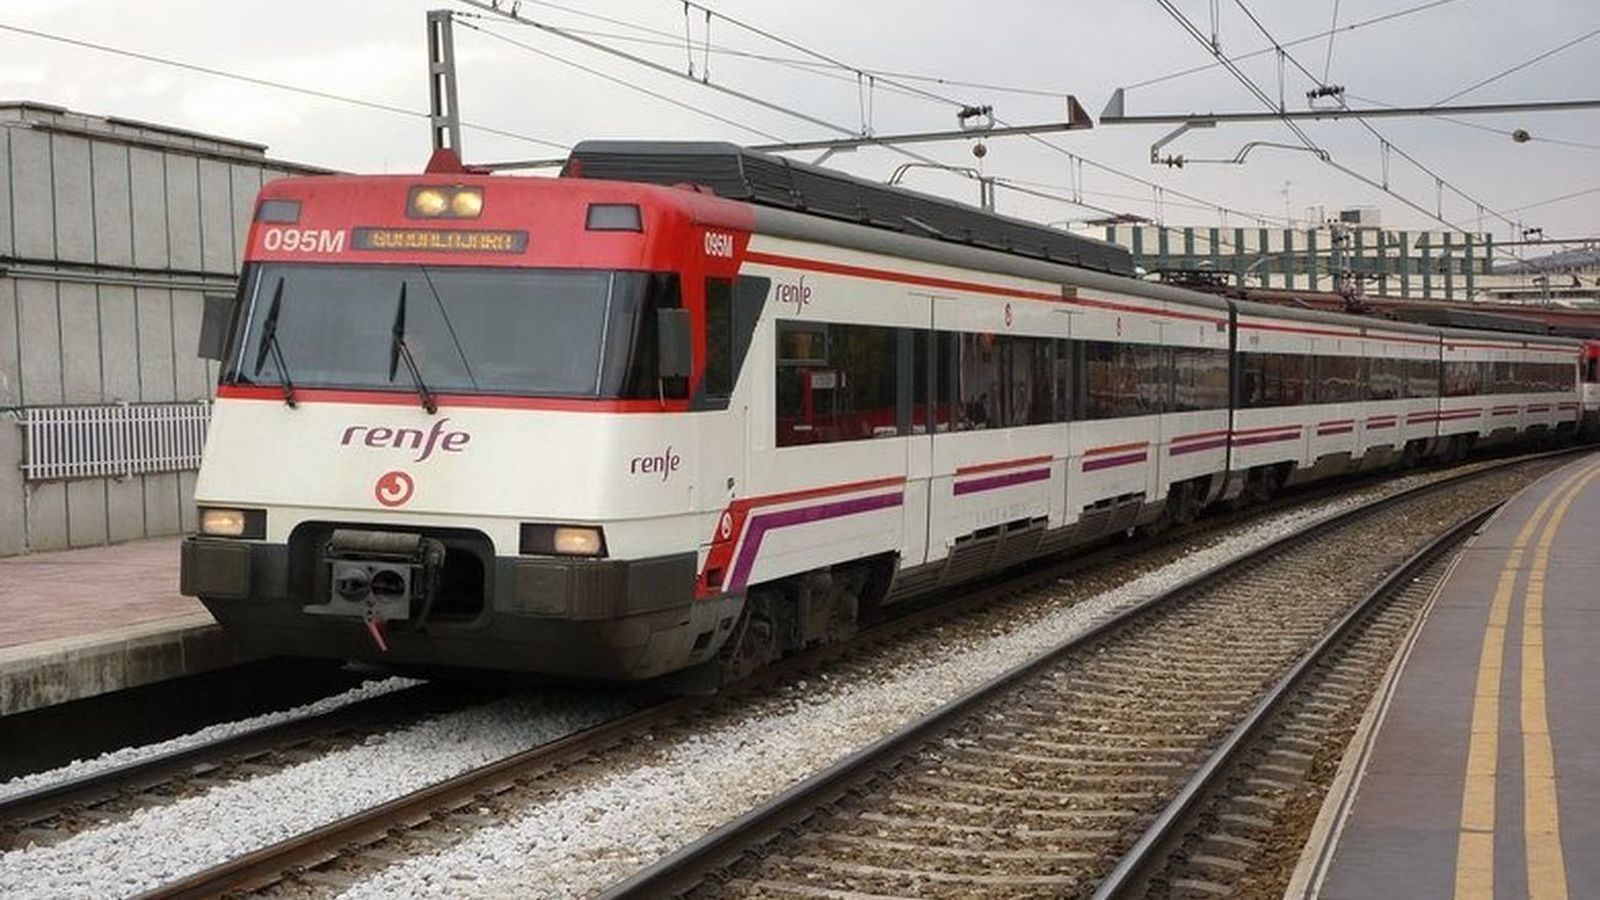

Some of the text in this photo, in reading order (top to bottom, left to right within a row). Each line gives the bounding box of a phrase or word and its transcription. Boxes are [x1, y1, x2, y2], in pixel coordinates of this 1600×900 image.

[264, 228, 345, 253] 095M
[775, 275, 811, 315] renfe
[341, 418, 471, 462] renfe
[630, 445, 680, 482] renfe
